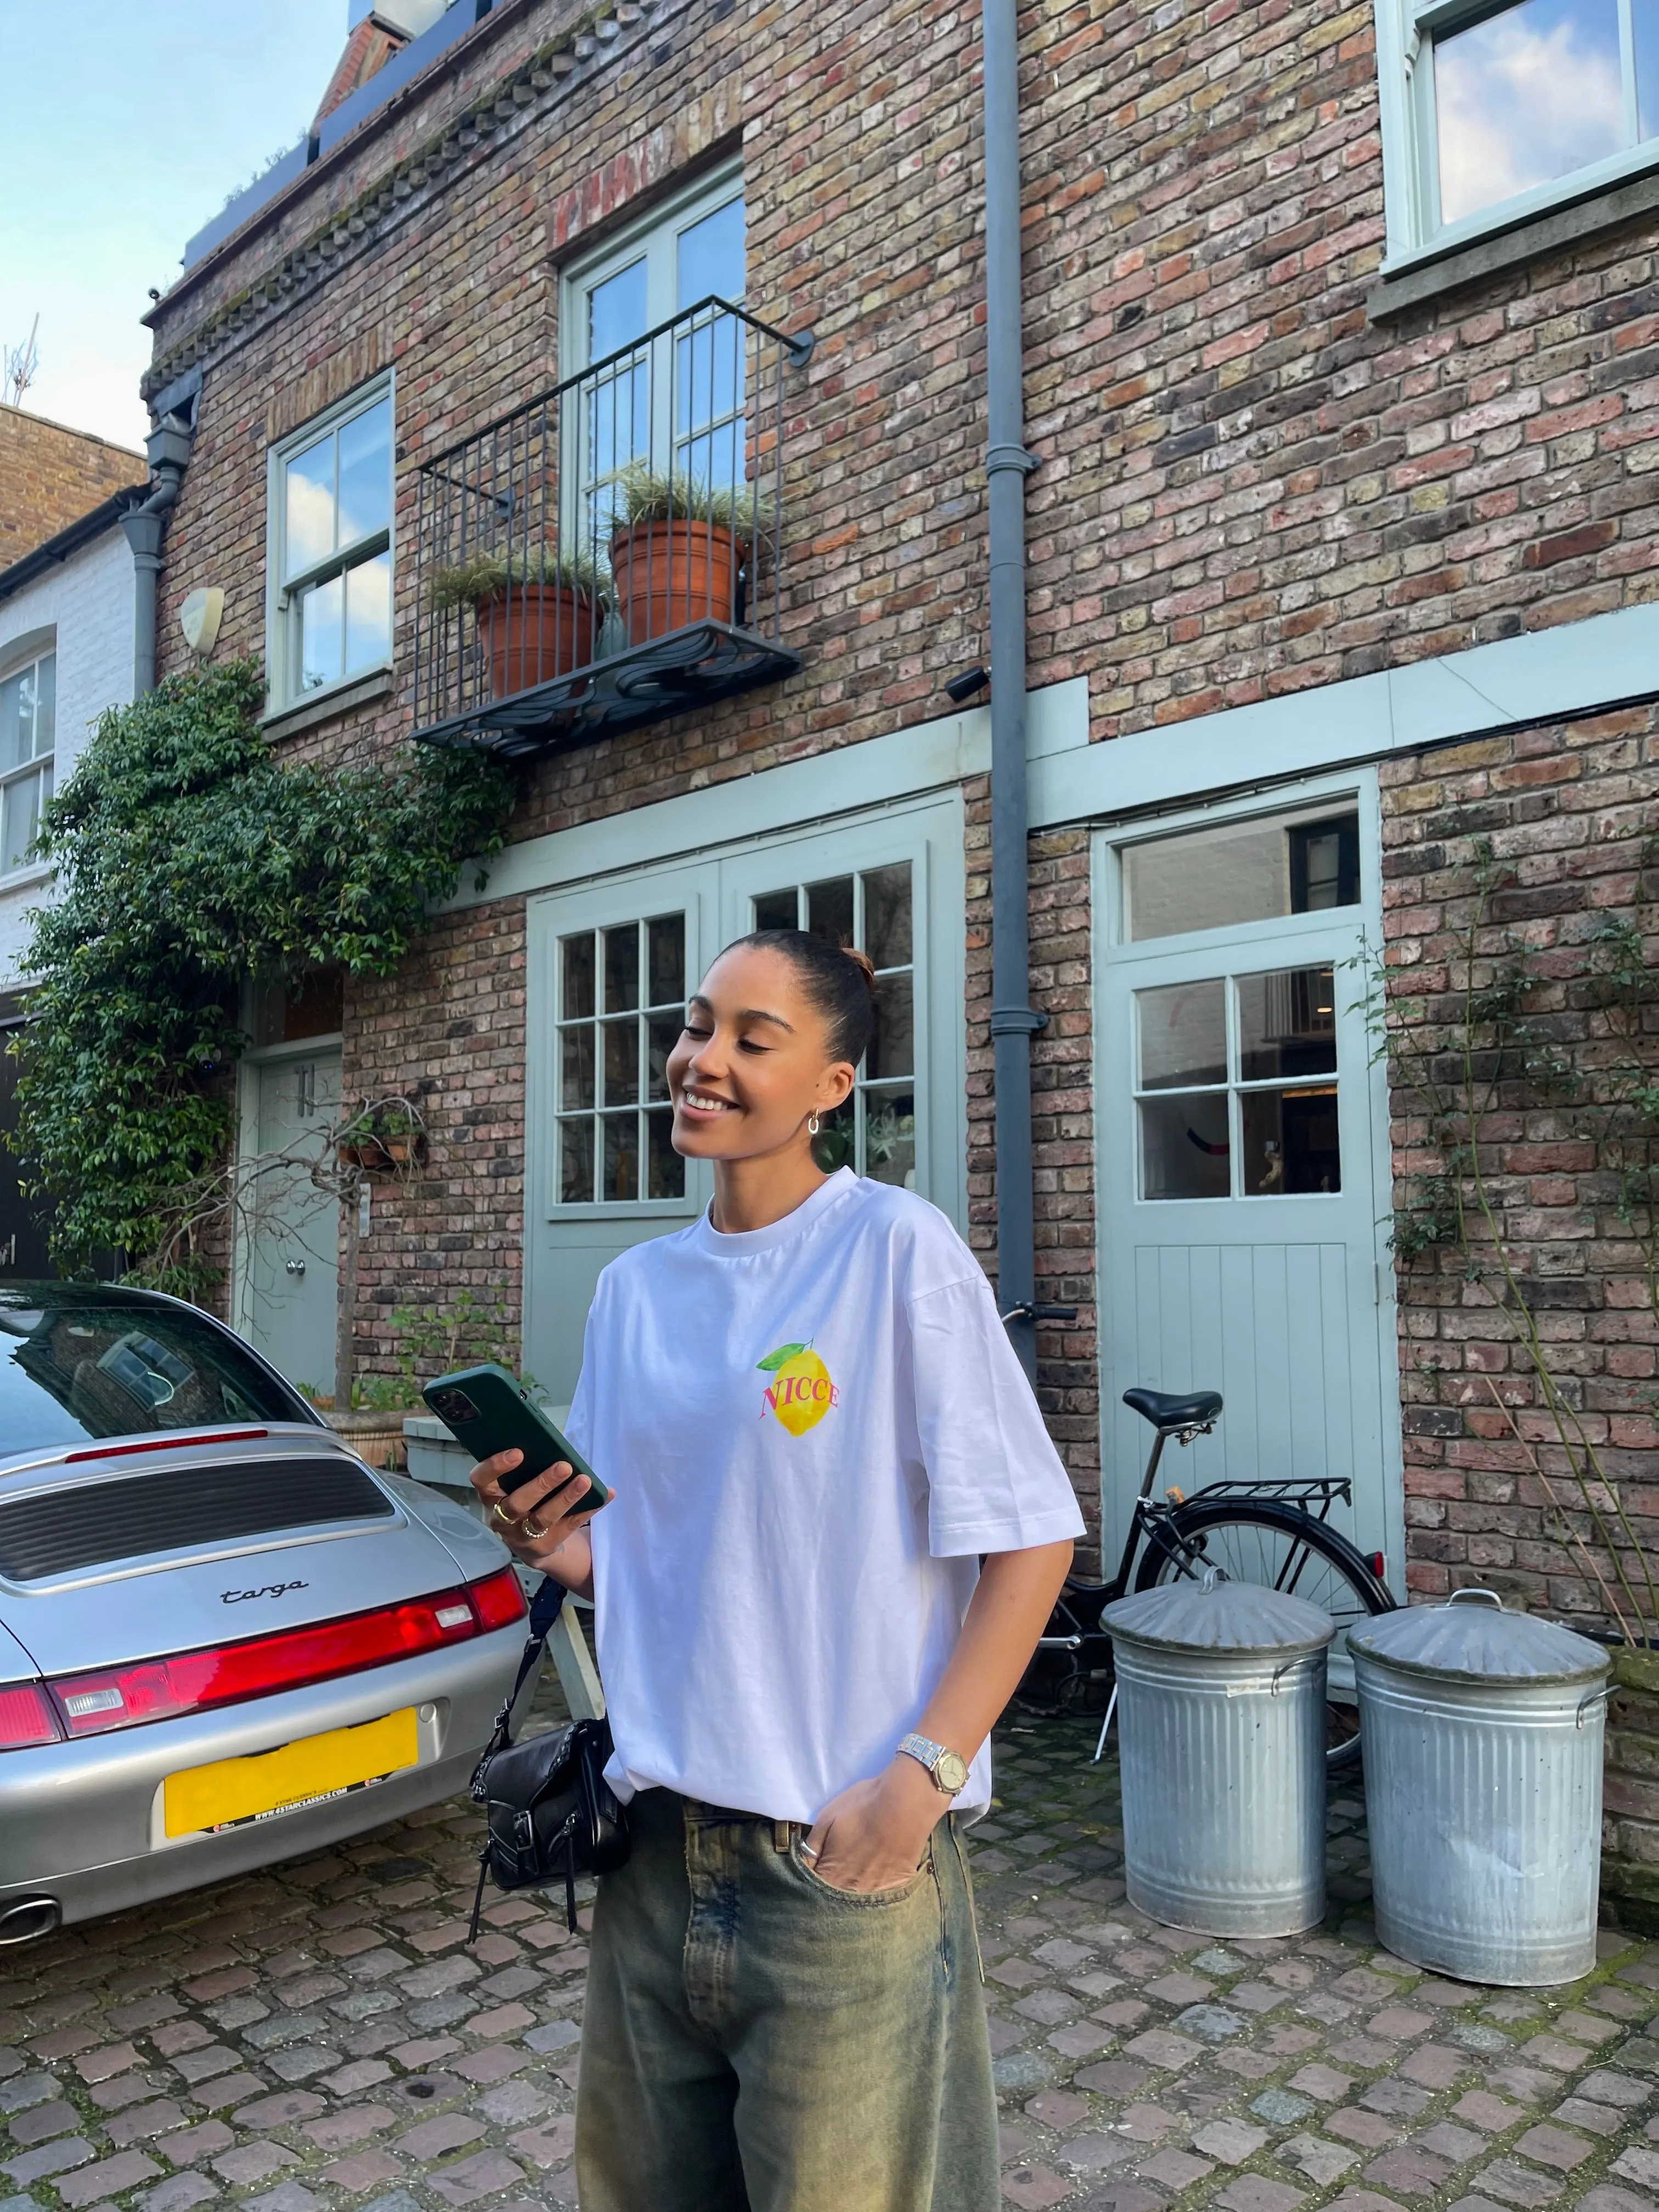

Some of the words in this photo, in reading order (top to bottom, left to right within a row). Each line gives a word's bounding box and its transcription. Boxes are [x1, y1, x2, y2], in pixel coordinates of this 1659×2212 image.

[759, 1376, 840, 1420] NICCE
[220, 1581, 309, 1604] targa
[255, 1787, 347, 1820] WWW.4STARCLASSICS.COM
